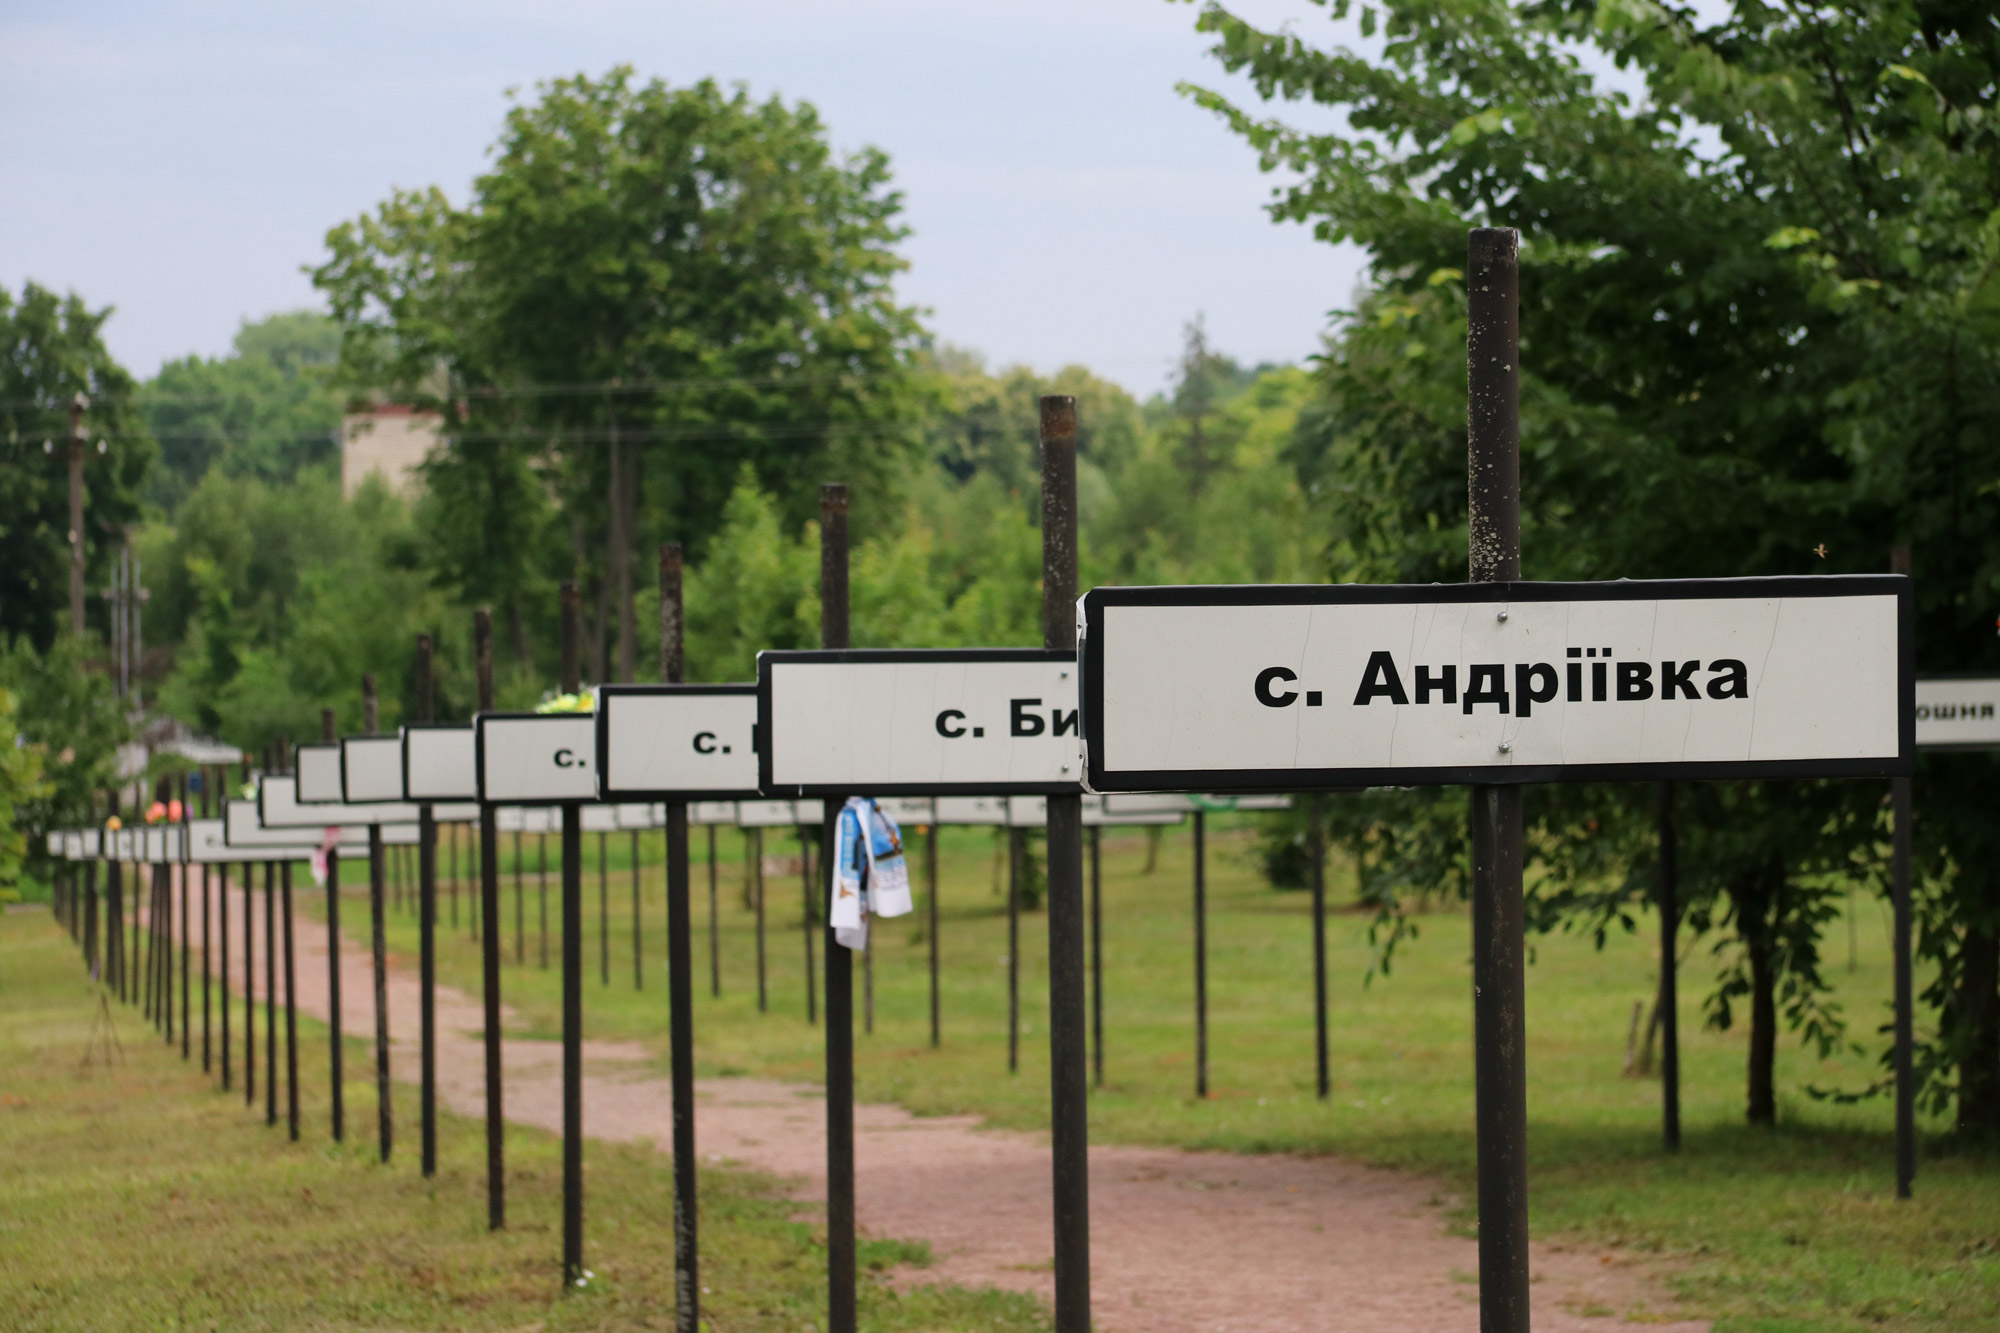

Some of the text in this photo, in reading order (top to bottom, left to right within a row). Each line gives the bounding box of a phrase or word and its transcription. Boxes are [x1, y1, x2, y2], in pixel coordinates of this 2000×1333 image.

[1254, 647, 1749, 718] с. Андріївка
[935, 709, 985, 738] с.
[692, 731, 731, 754] с.
[553, 749, 586, 768] с.
